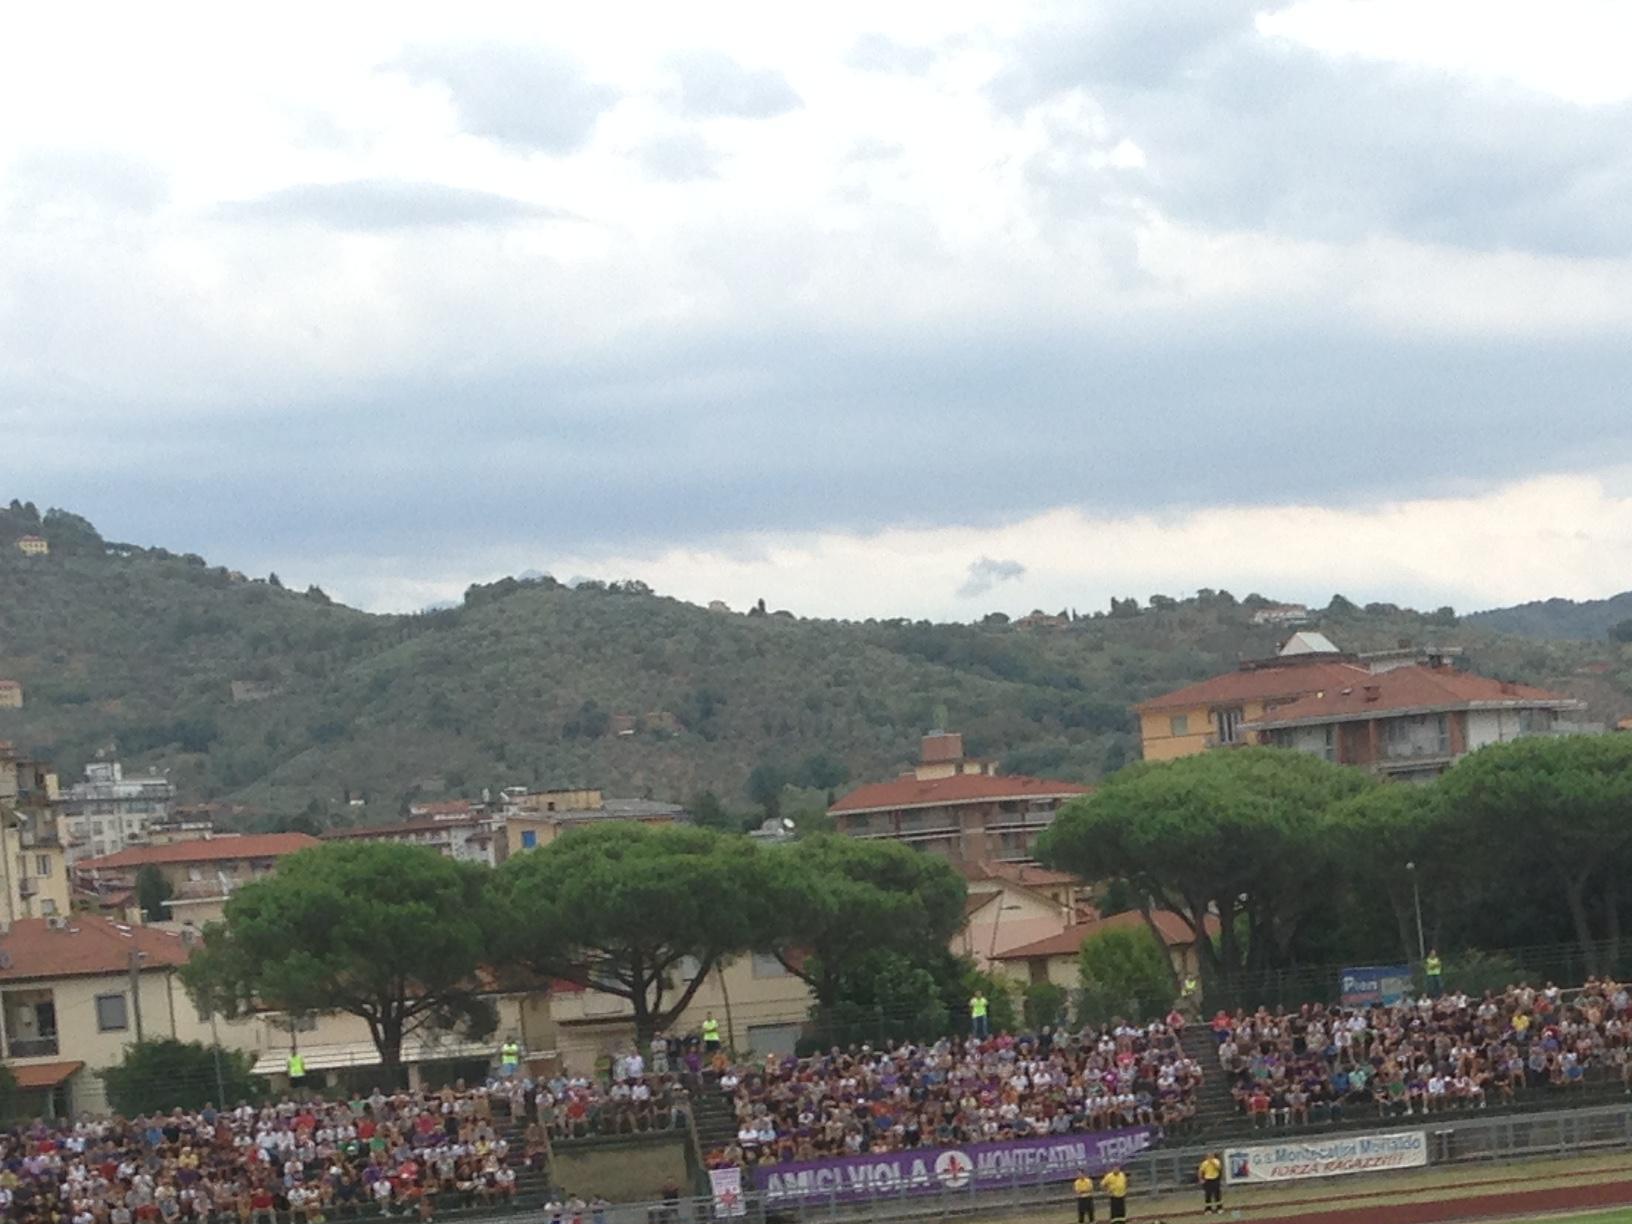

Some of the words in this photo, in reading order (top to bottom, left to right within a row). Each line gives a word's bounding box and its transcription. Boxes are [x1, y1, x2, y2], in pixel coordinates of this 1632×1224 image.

[767, 1167, 842, 1200] AMICI
[849, 1158, 931, 1192] VIOLA
[977, 1143, 1088, 1178] MONTECATINI
[1270, 1162, 1319, 1177] FORZA
